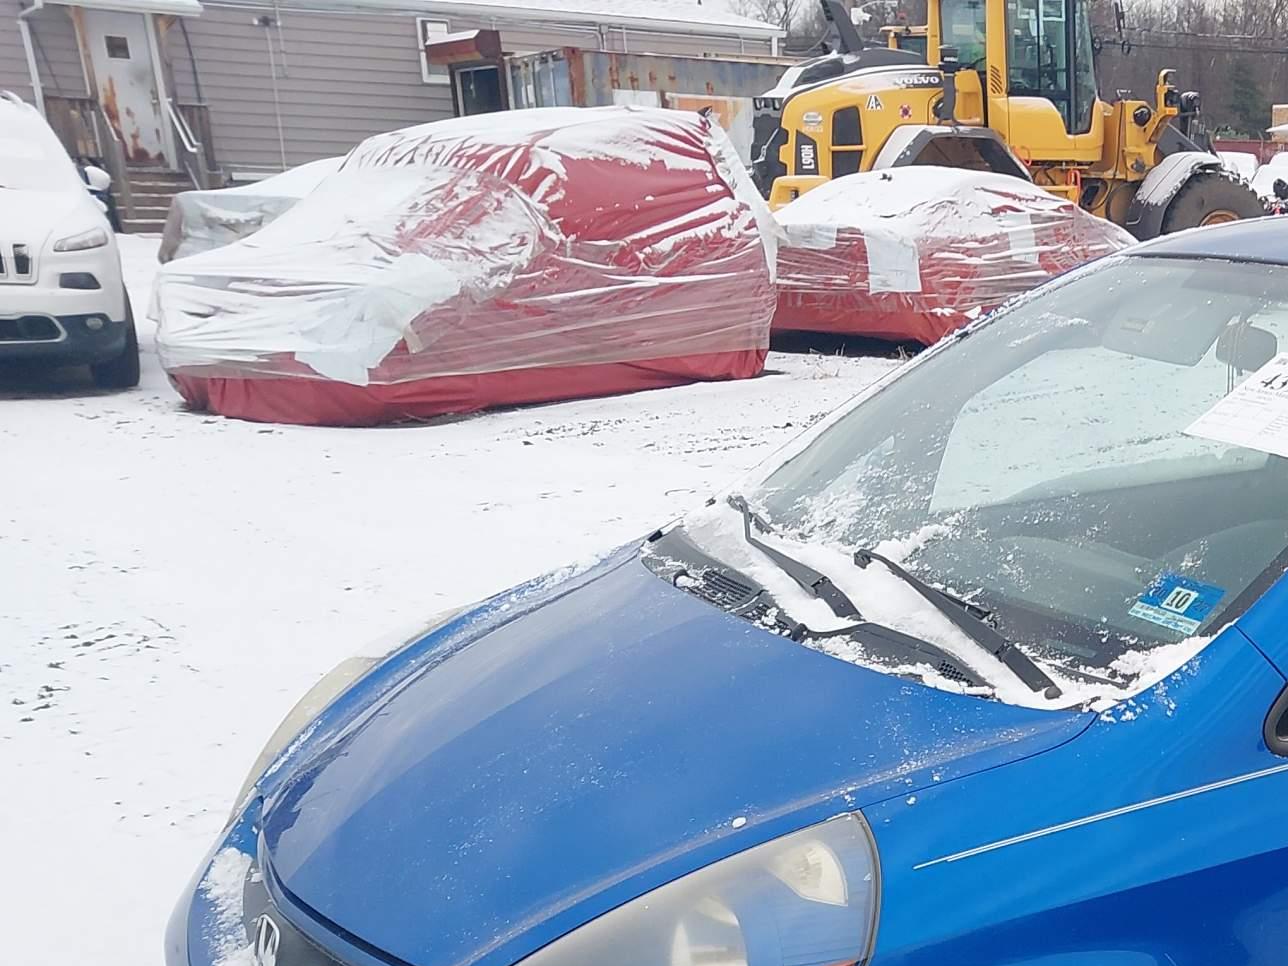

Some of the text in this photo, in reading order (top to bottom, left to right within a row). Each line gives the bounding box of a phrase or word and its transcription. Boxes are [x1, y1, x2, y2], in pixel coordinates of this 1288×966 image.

[895, 75, 939, 85] VOLVO
[801, 144, 815, 169] L90H
[1166, 590, 1192, 610] 10
